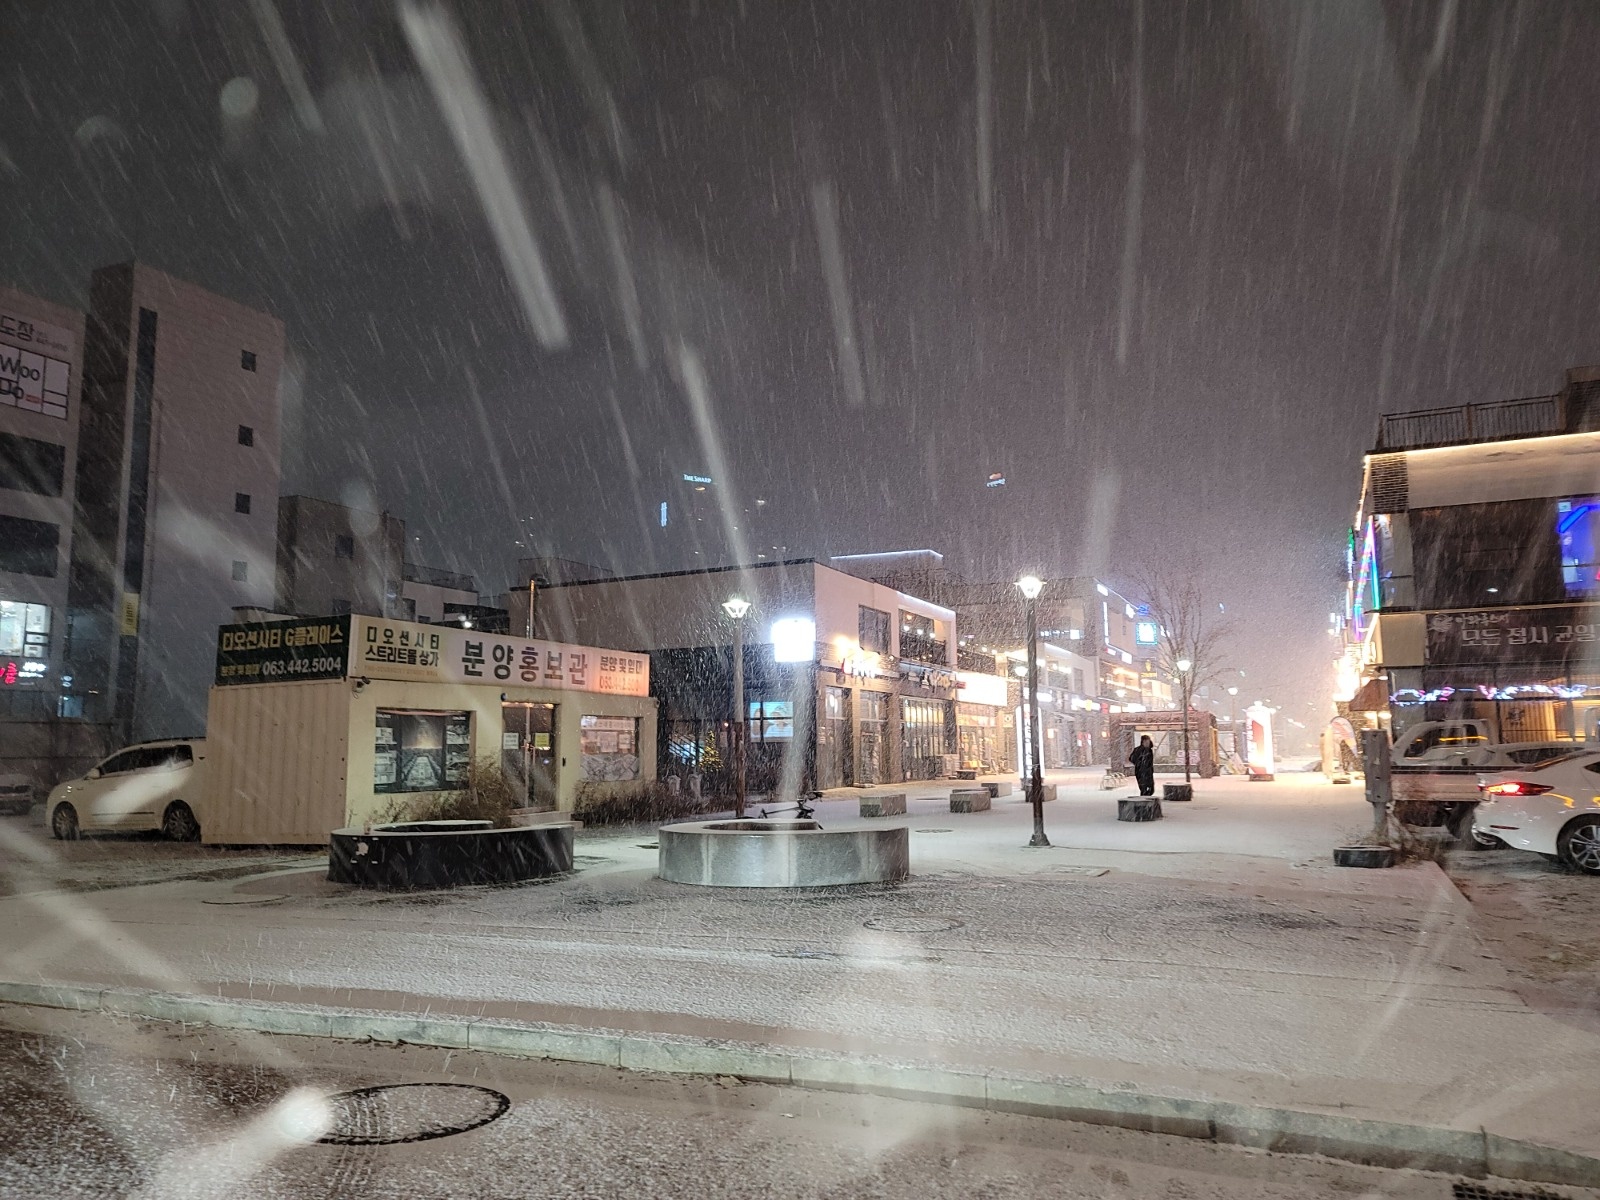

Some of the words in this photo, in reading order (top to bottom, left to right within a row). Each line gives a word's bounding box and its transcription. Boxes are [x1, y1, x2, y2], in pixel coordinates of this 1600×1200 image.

[0, 315, 34, 342] 도장
[222, 629, 281, 652] 디오션시티
[285, 624, 343, 647] G플레이스
[366, 625, 440, 650] 디오션시티
[1461, 628, 1502, 647] 모든
[1507, 625, 1549, 646] 접시
[262, 656, 342, 676] 063.442.5004
[365, 645, 417, 666] 스트리트몰
[419, 650, 440, 667] 상가
[461, 640, 588, 686] 분양홍보관
[600, 655, 617, 672] 분양
